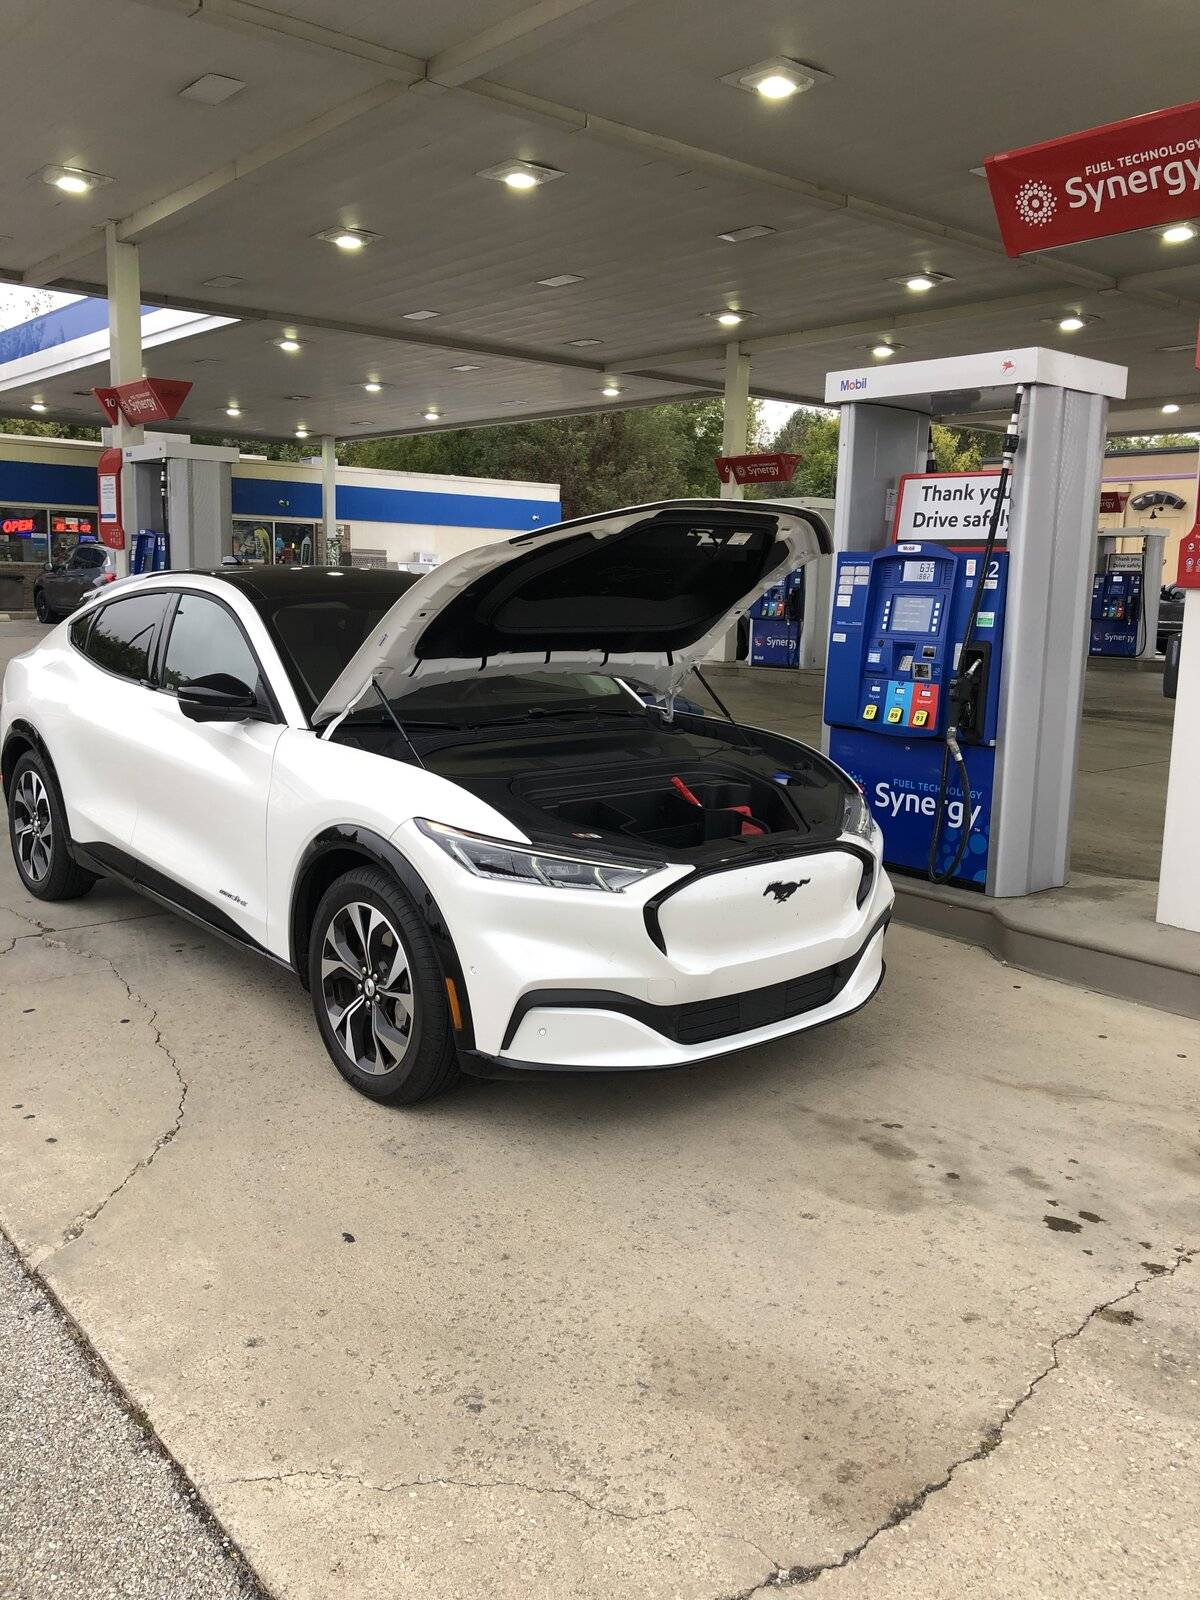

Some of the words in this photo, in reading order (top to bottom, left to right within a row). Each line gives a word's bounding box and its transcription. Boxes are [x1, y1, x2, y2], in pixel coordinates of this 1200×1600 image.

[1085, 161, 1115, 176] FUEL
[1065, 157, 1200, 213] Synergy
[840, 377, 867, 391] Mobil
[105, 398, 116, 408] 10
[128, 397, 157, 414] Synergy
[746, 466, 779, 477] Synergy
[921, 483, 975, 501] Thank
[2, 519, 33, 533] OPEN
[913, 510, 958, 528] Drive
[988, 561, 1000, 578] 2
[893, 778, 916, 790] FUEL
[918, 782, 982, 800] TECHOLGY
[875, 782, 982, 831] Synegy
